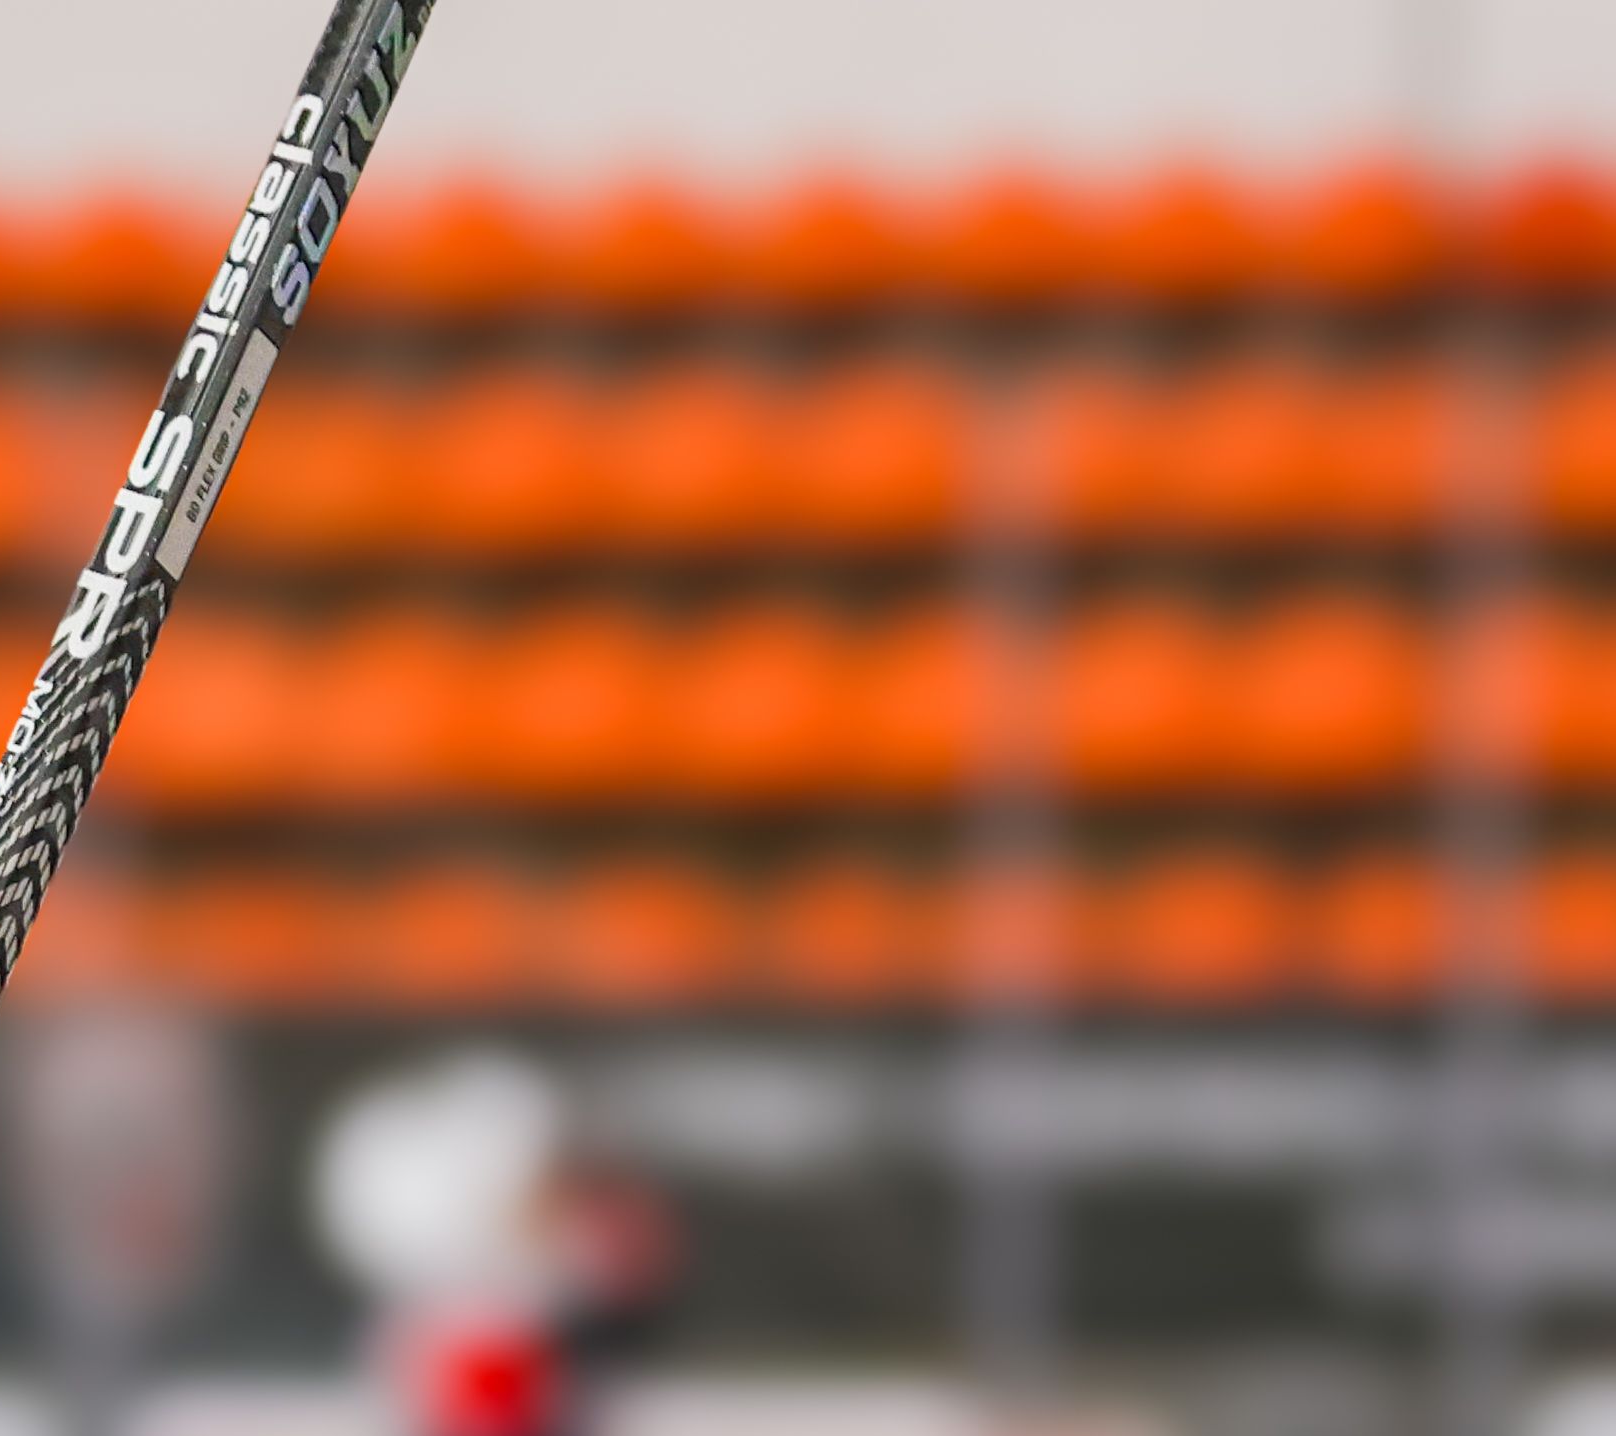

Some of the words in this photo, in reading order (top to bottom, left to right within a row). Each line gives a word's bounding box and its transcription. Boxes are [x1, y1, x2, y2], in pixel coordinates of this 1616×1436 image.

[177, 93, 324, 383] classic
[272, 1, 417, 326] SOYUZ
[51, 410, 193, 659] SPR
